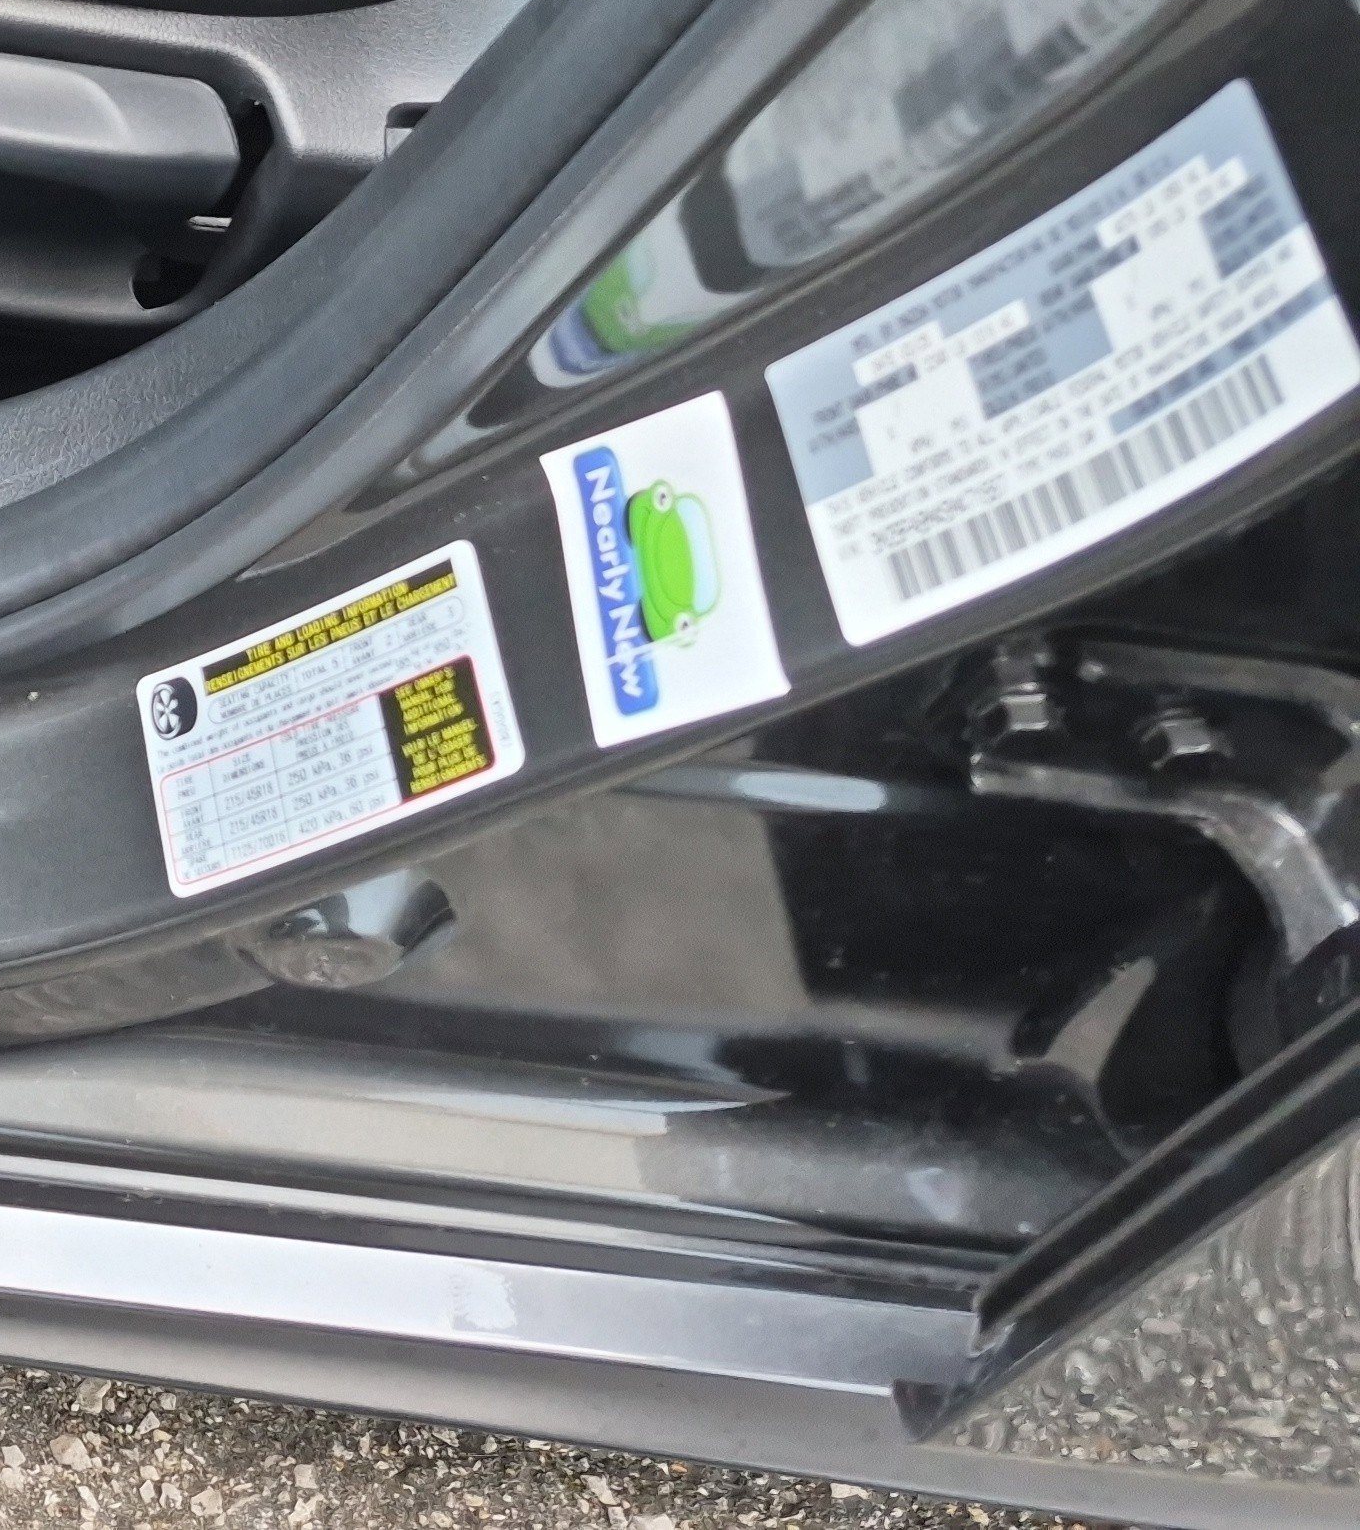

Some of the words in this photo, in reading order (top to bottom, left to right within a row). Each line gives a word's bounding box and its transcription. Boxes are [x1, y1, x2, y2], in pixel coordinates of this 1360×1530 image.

[585, 466, 631, 601] Nearly
[246, 641, 272, 660] TIRE
[273, 632, 295, 649] AND
[295, 612, 341, 639] LOADING
[341, 581, 410, 619] INFORMATION
[285, 641, 307, 658] SUR
[307, 632, 329, 649] LES
[329, 618, 362, 639] PNEUS
[362, 610, 379, 625] ET
[379, 602, 396, 617] LE
[395, 575, 457, 610] CHARGEMENT
[286, 768, 307, 785] 250
